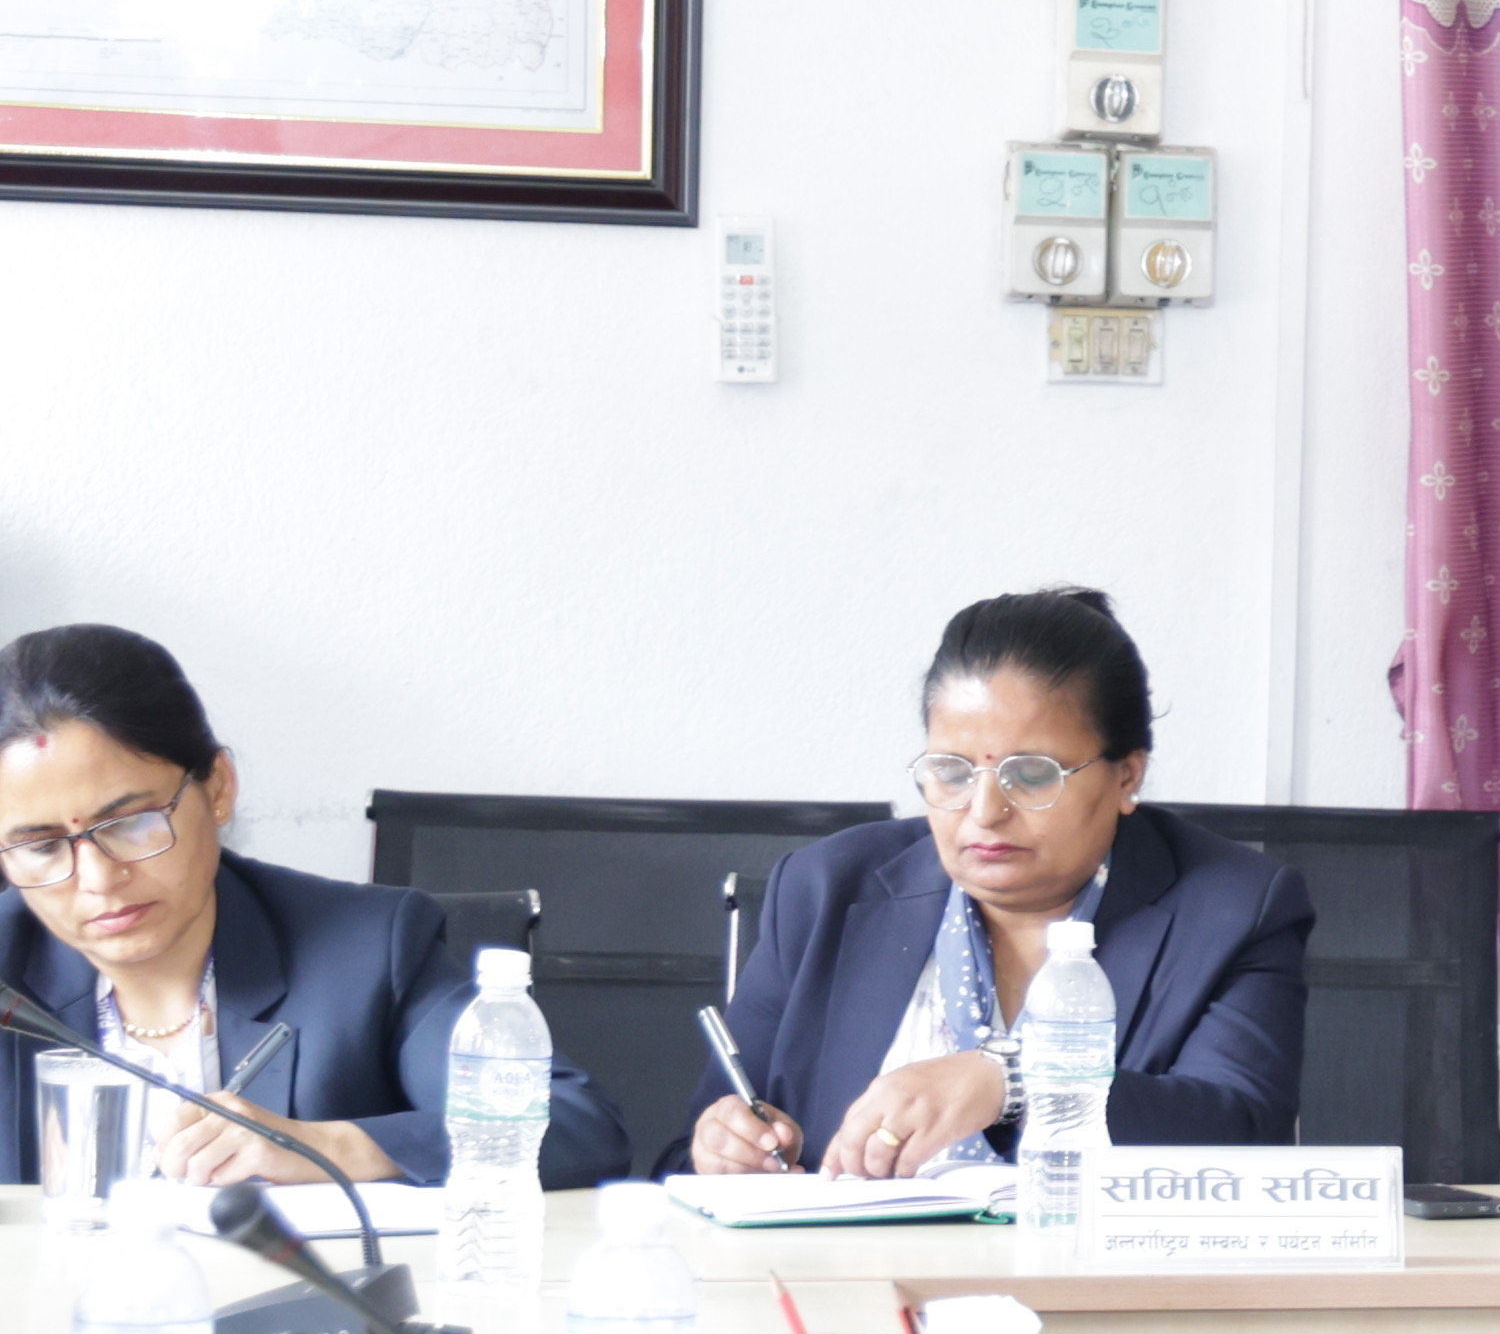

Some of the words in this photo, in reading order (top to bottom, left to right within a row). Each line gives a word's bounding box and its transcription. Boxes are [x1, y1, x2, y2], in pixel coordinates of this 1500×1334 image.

[1100, 1166, 1245, 1203] समिति
[1261, 1167, 1383, 1203] सचिव
[1199, 1234, 1249, 1251] सम्बन्ध
[1257, 1234, 1270, 1250] र
[1277, 1228, 1321, 1251] पर्यटन
[1330, 1229, 1379, 1251] समिति
